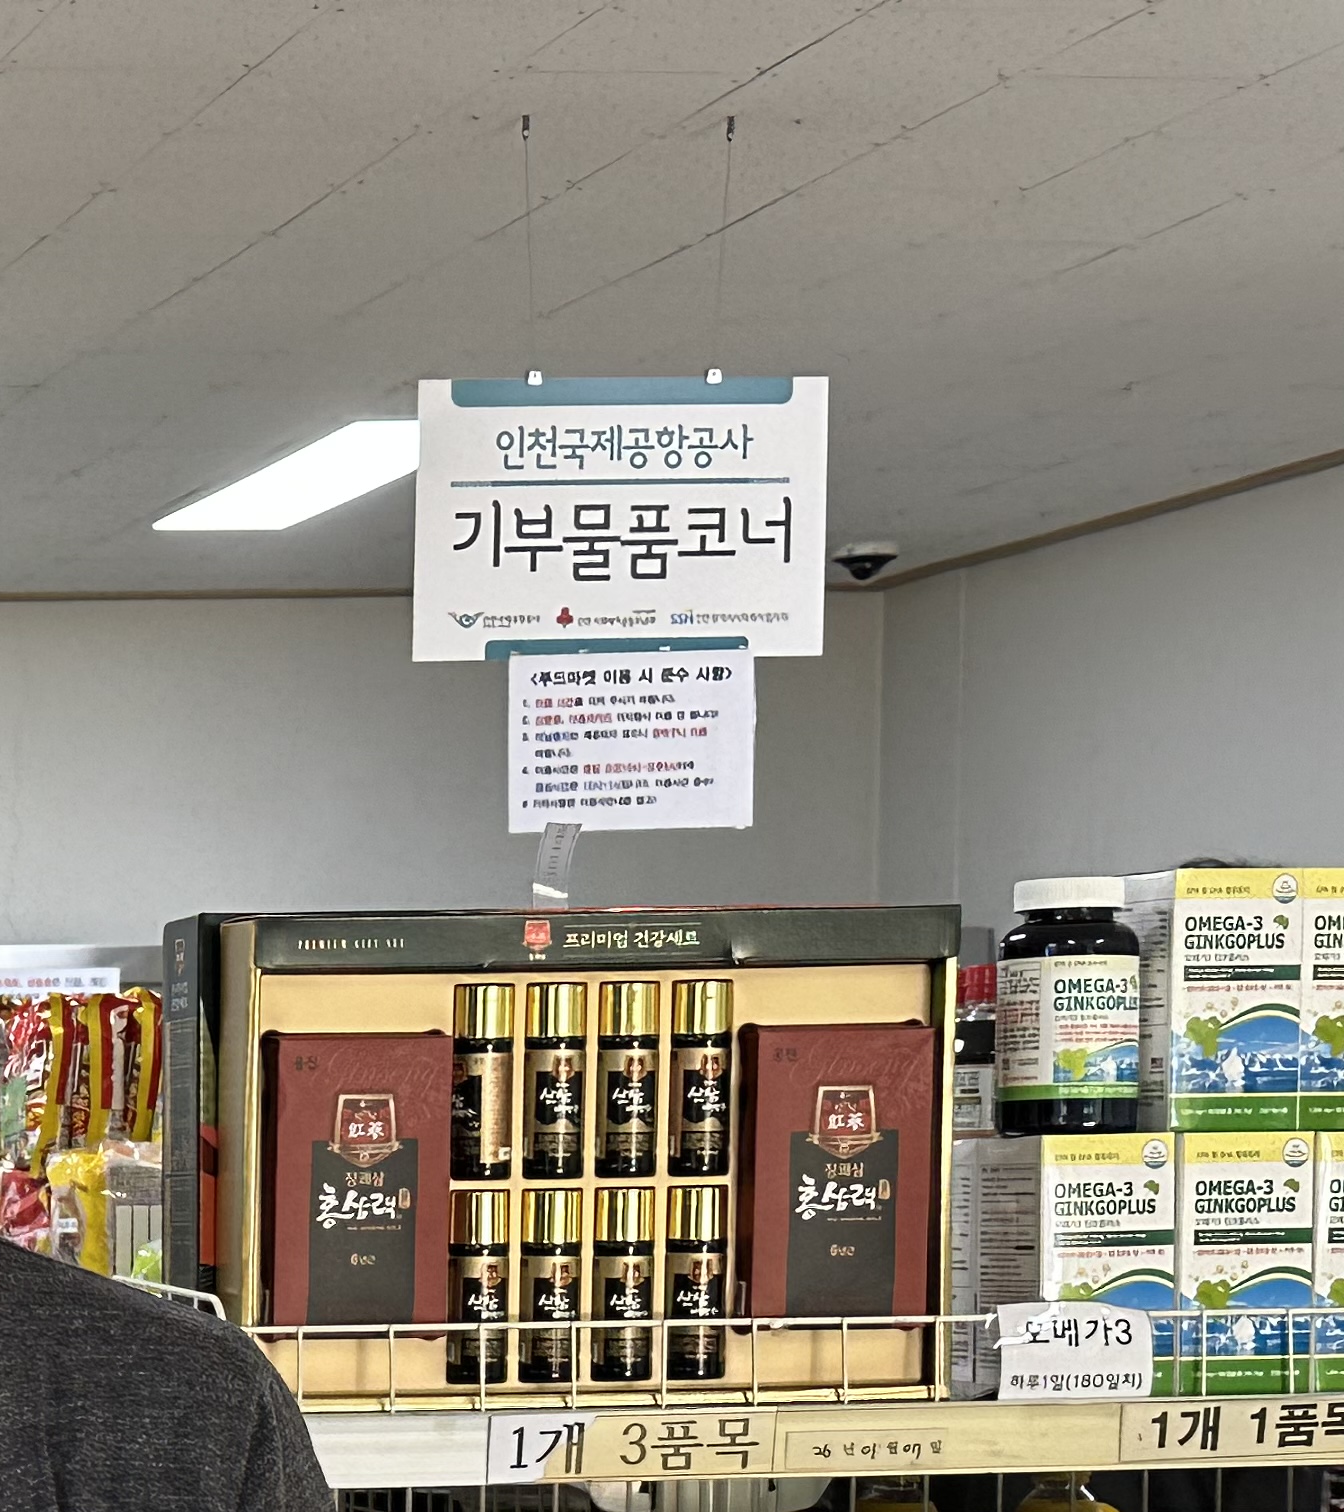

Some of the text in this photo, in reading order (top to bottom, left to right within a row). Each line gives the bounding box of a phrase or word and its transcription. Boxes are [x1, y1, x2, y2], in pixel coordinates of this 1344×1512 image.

[496, 424, 754, 470] 인천국제공항공사
[452, 496, 793, 582] 기부물품코너
[1184, 916, 1263, 932] OMEGA-3
[563, 930, 629, 949] 프리미엄
[1184, 934, 1285, 950] GINKGOPLUS
[1053, 978, 1128, 994] OMEGA-3
[1054, 1181, 1134, 1198] OMEGA-3
[1195, 1180, 1274, 1196] OMEGA-3
[1054, 1199, 1156, 1216] GINKGOPLUS
[1194, 1197, 1296, 1214] GINKGOPLUS
[1026, 1318, 1133, 1347] 오메가3
[1151, 1406, 1221, 1451] 1개
[509, 1417, 760, 1474] 1개 3품목
